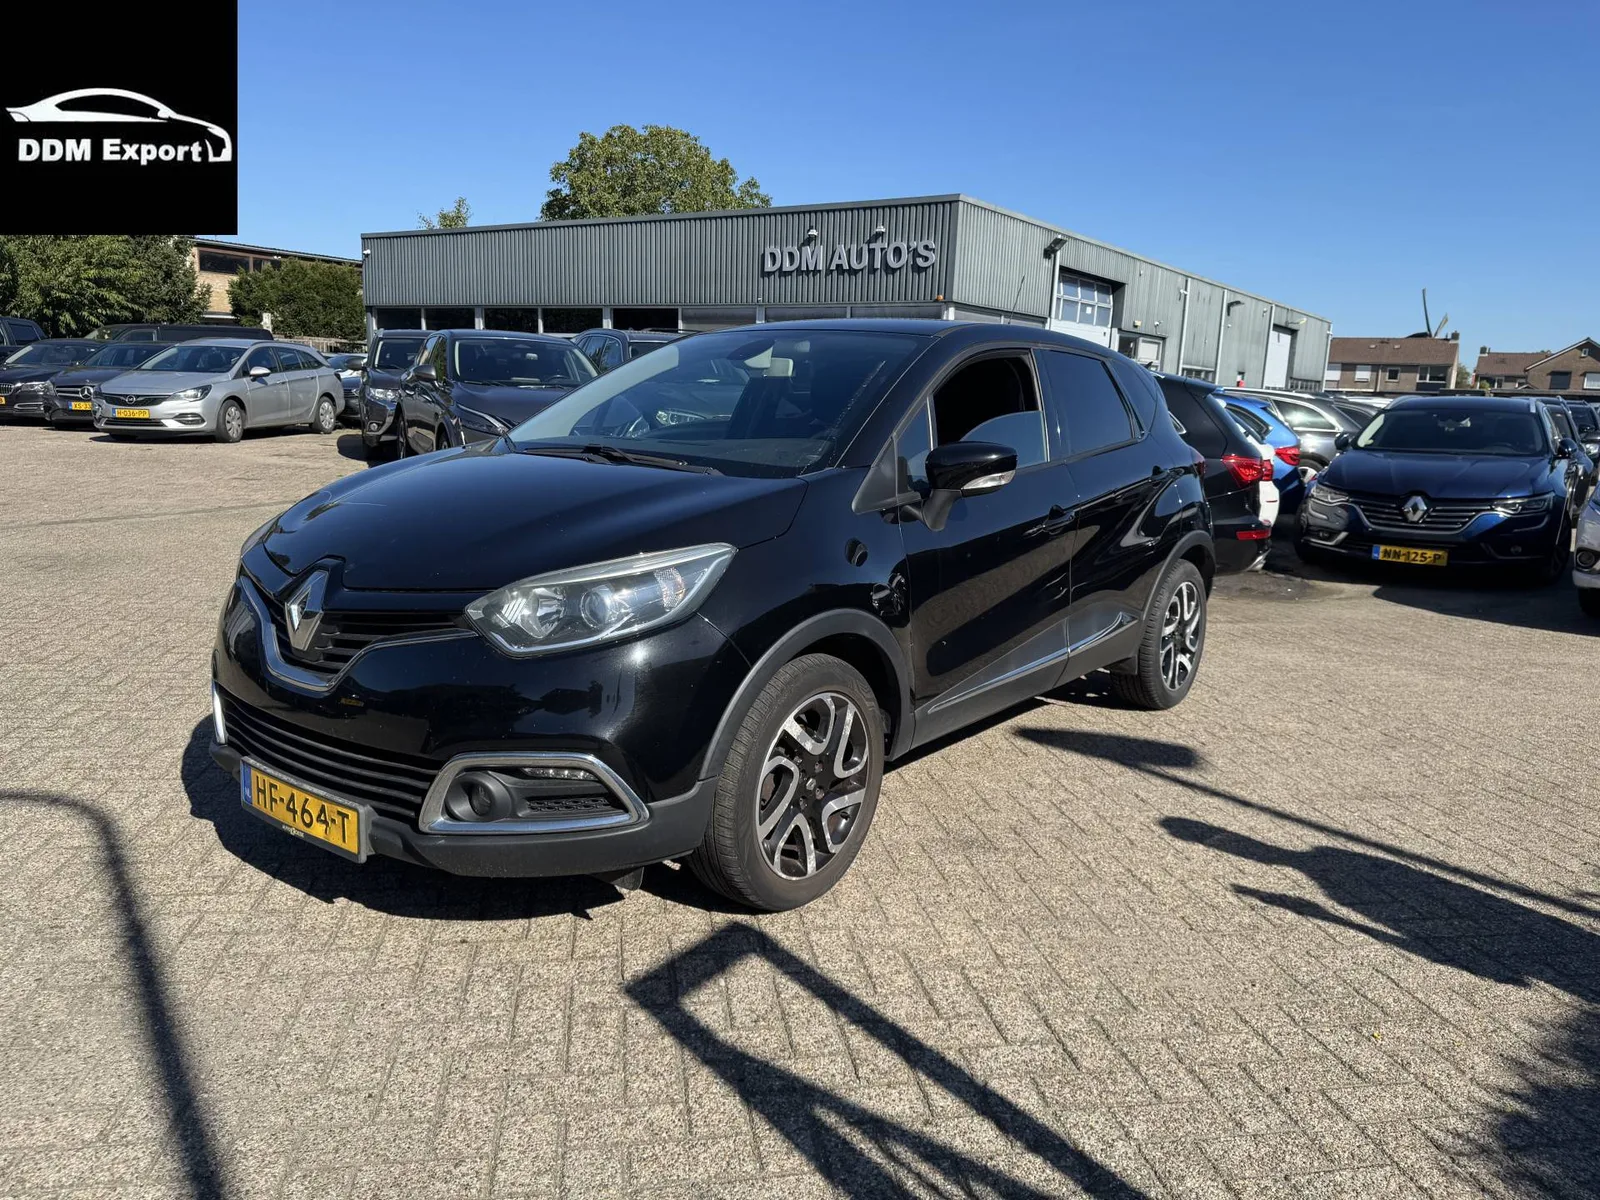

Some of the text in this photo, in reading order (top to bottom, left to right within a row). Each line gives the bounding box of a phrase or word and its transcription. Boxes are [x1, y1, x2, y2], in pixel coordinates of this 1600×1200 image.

[764, 239, 936, 272] DDM AUTO'S
[1382, 548, 1441, 564] NN-125-P
[256, 775, 350, 845] HF-464-T
